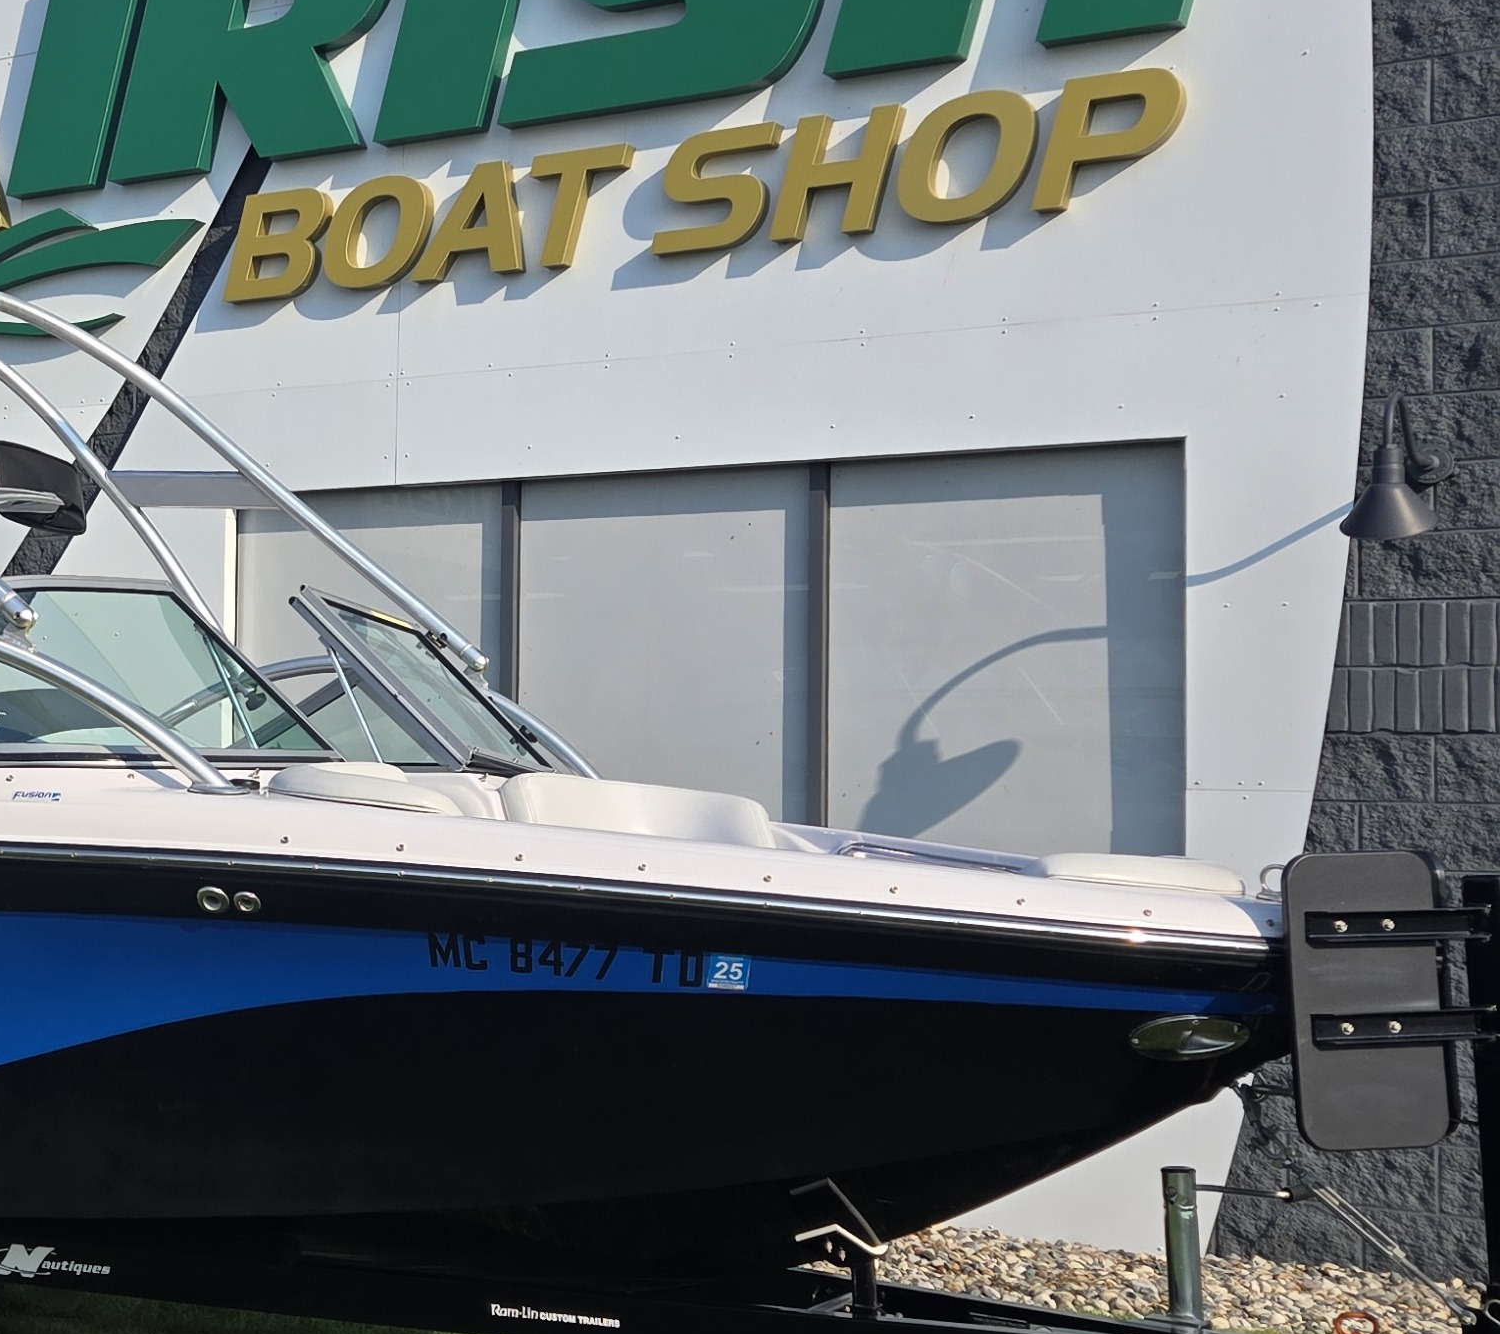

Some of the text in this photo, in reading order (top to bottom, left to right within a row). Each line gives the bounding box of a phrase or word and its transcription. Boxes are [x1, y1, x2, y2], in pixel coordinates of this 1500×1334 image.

[222, 66, 1188, 305] BOAT SHOP
[426, 931, 489, 971] MC
[509, 936, 620, 981] 8477
[713, 961, 744, 981] 25
[540, 1312, 577, 1324] CUSTOM
[578, 1315, 620, 1328] TRAILERS
